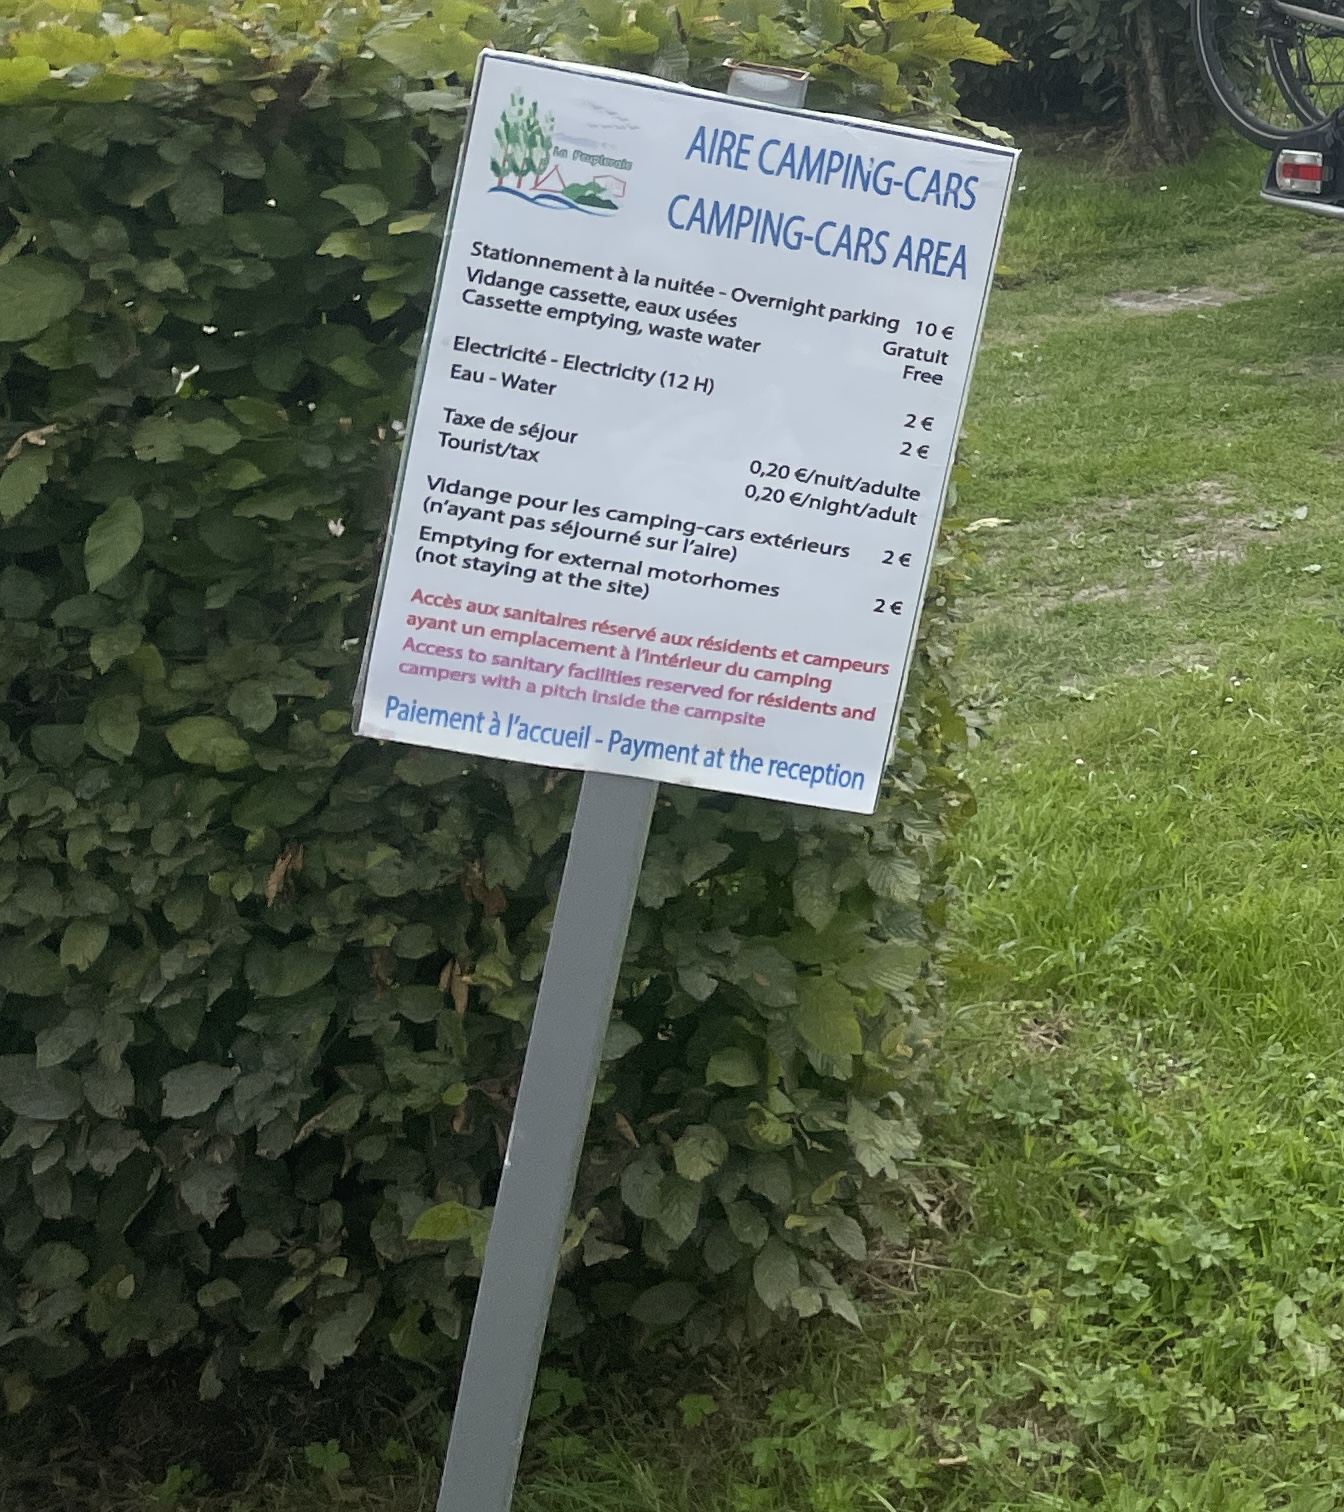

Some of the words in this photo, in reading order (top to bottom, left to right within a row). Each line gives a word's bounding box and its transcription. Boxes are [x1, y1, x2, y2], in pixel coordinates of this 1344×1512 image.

[684, 125, 755, 171] AIRE
[757, 138, 980, 211] CAMPING-CARS
[667, 194, 891, 266] CAMPING-CARS
[892, 234, 967, 281] AREA
[466, 265, 545, 297] Vidange
[548, 285, 631, 313] cassette,
[634, 299, 682, 319] eaux
[685, 307, 738, 329] usées
[882, 340, 950, 366] Gratuit
[469, 240, 615, 281] Stationnement
[616, 266, 629, 284] à
[633, 268, 650, 287] la
[653, 276, 715, 298] nuitée
[730, 287, 827, 318] Overnight
[827, 307, 901, 334] parking
[915, 320, 938, 337] 10
[940, 325, 955, 341] €
[461, 288, 543, 317] Cassette
[546, 306, 643, 336] emptying,
[648, 322, 704, 344] waste
[707, 333, 762, 354] water
[902, 364, 944, 386] Free
[449, 363, 485, 384] Eau
[501, 371, 558, 396] Water
[899, 441, 913, 457] 2
[916, 444, 930, 460] €
[452, 335, 547, 366] Electricité
[562, 353, 657, 387] Electricity
[659, 370, 690, 390] (12
[693, 375, 715, 396] H)
[903, 413, 917, 429] 2
[920, 416, 935, 432] €
[438, 430, 541, 464] Tourist/tax
[744, 483, 786, 504] 0,20
[788, 491, 918, 526] €/night/adult
[443, 406, 486, 430] Taxe
[489, 415, 515, 435] de
[517, 421, 579, 444] séjour
[749, 459, 791, 480] 0,20
[793, 467, 921, 502] €/nuit/adulte
[426, 474, 513, 506] Vidange
[516, 493, 569, 513] pour
[572, 498, 601, 519] les
[605, 508, 746, 542] camping-cars
[749, 532, 851, 558] extérieurs
[881, 549, 895, 566] 2
[898, 552, 913, 568] €
[508, 514, 546, 531] pas
[549, 519, 642, 547] séjourné
[644, 536, 679, 552] sur
[415, 545, 458, 568] (not
[461, 556, 538, 584] staying
[541, 570, 564, 585] at
[567, 571, 603, 591] the
[605, 579, 650, 601] site)
[418, 525, 520, 560] Emptying
[523, 542, 555, 562] for
[557, 552, 644, 577] external
[646, 566, 781, 598] motorhomes
[872, 598, 886, 614] 2
[889, 600, 904, 616] €
[406, 614, 458, 633] ayant
[461, 623, 486, 638] un
[489, 628, 618, 659] emplacement
[724, 661, 750, 679] du
[753, 668, 833, 694] camping
[410, 588, 463, 611] Accès
[465, 601, 500, 617] aux
[502, 607, 588, 631] sanitaires
[591, 619, 657, 642] réservé
[659, 632, 694, 648] aux
[696, 635, 778, 660] résidents
[780, 649, 800, 664] et
[802, 653, 890, 676] campeurs
[398, 662, 477, 684] campers
[481, 674, 521, 691] with
[525, 681, 537, 693] a
[540, 684, 587, 701] pitch
[592, 689, 646, 710] inside
[650, 697, 680, 715] the
[684, 706, 766, 728] campsite
[402, 636, 464, 660] Access
[467, 648, 487, 664] to
[491, 654, 565, 679] sanitary
[567, 662, 642, 688] facilities
[646, 678, 725, 700] reserved
[727, 686, 755, 704] for
[756, 692, 838, 717] résidents
[840, 706, 877, 722] and
[385, 695, 486, 734] Paiement
[488, 710, 501, 737] à
[607, 729, 700, 766] Payment
[703, 747, 726, 770] at
[729, 747, 764, 775] the
[767, 759, 865, 791] reception
